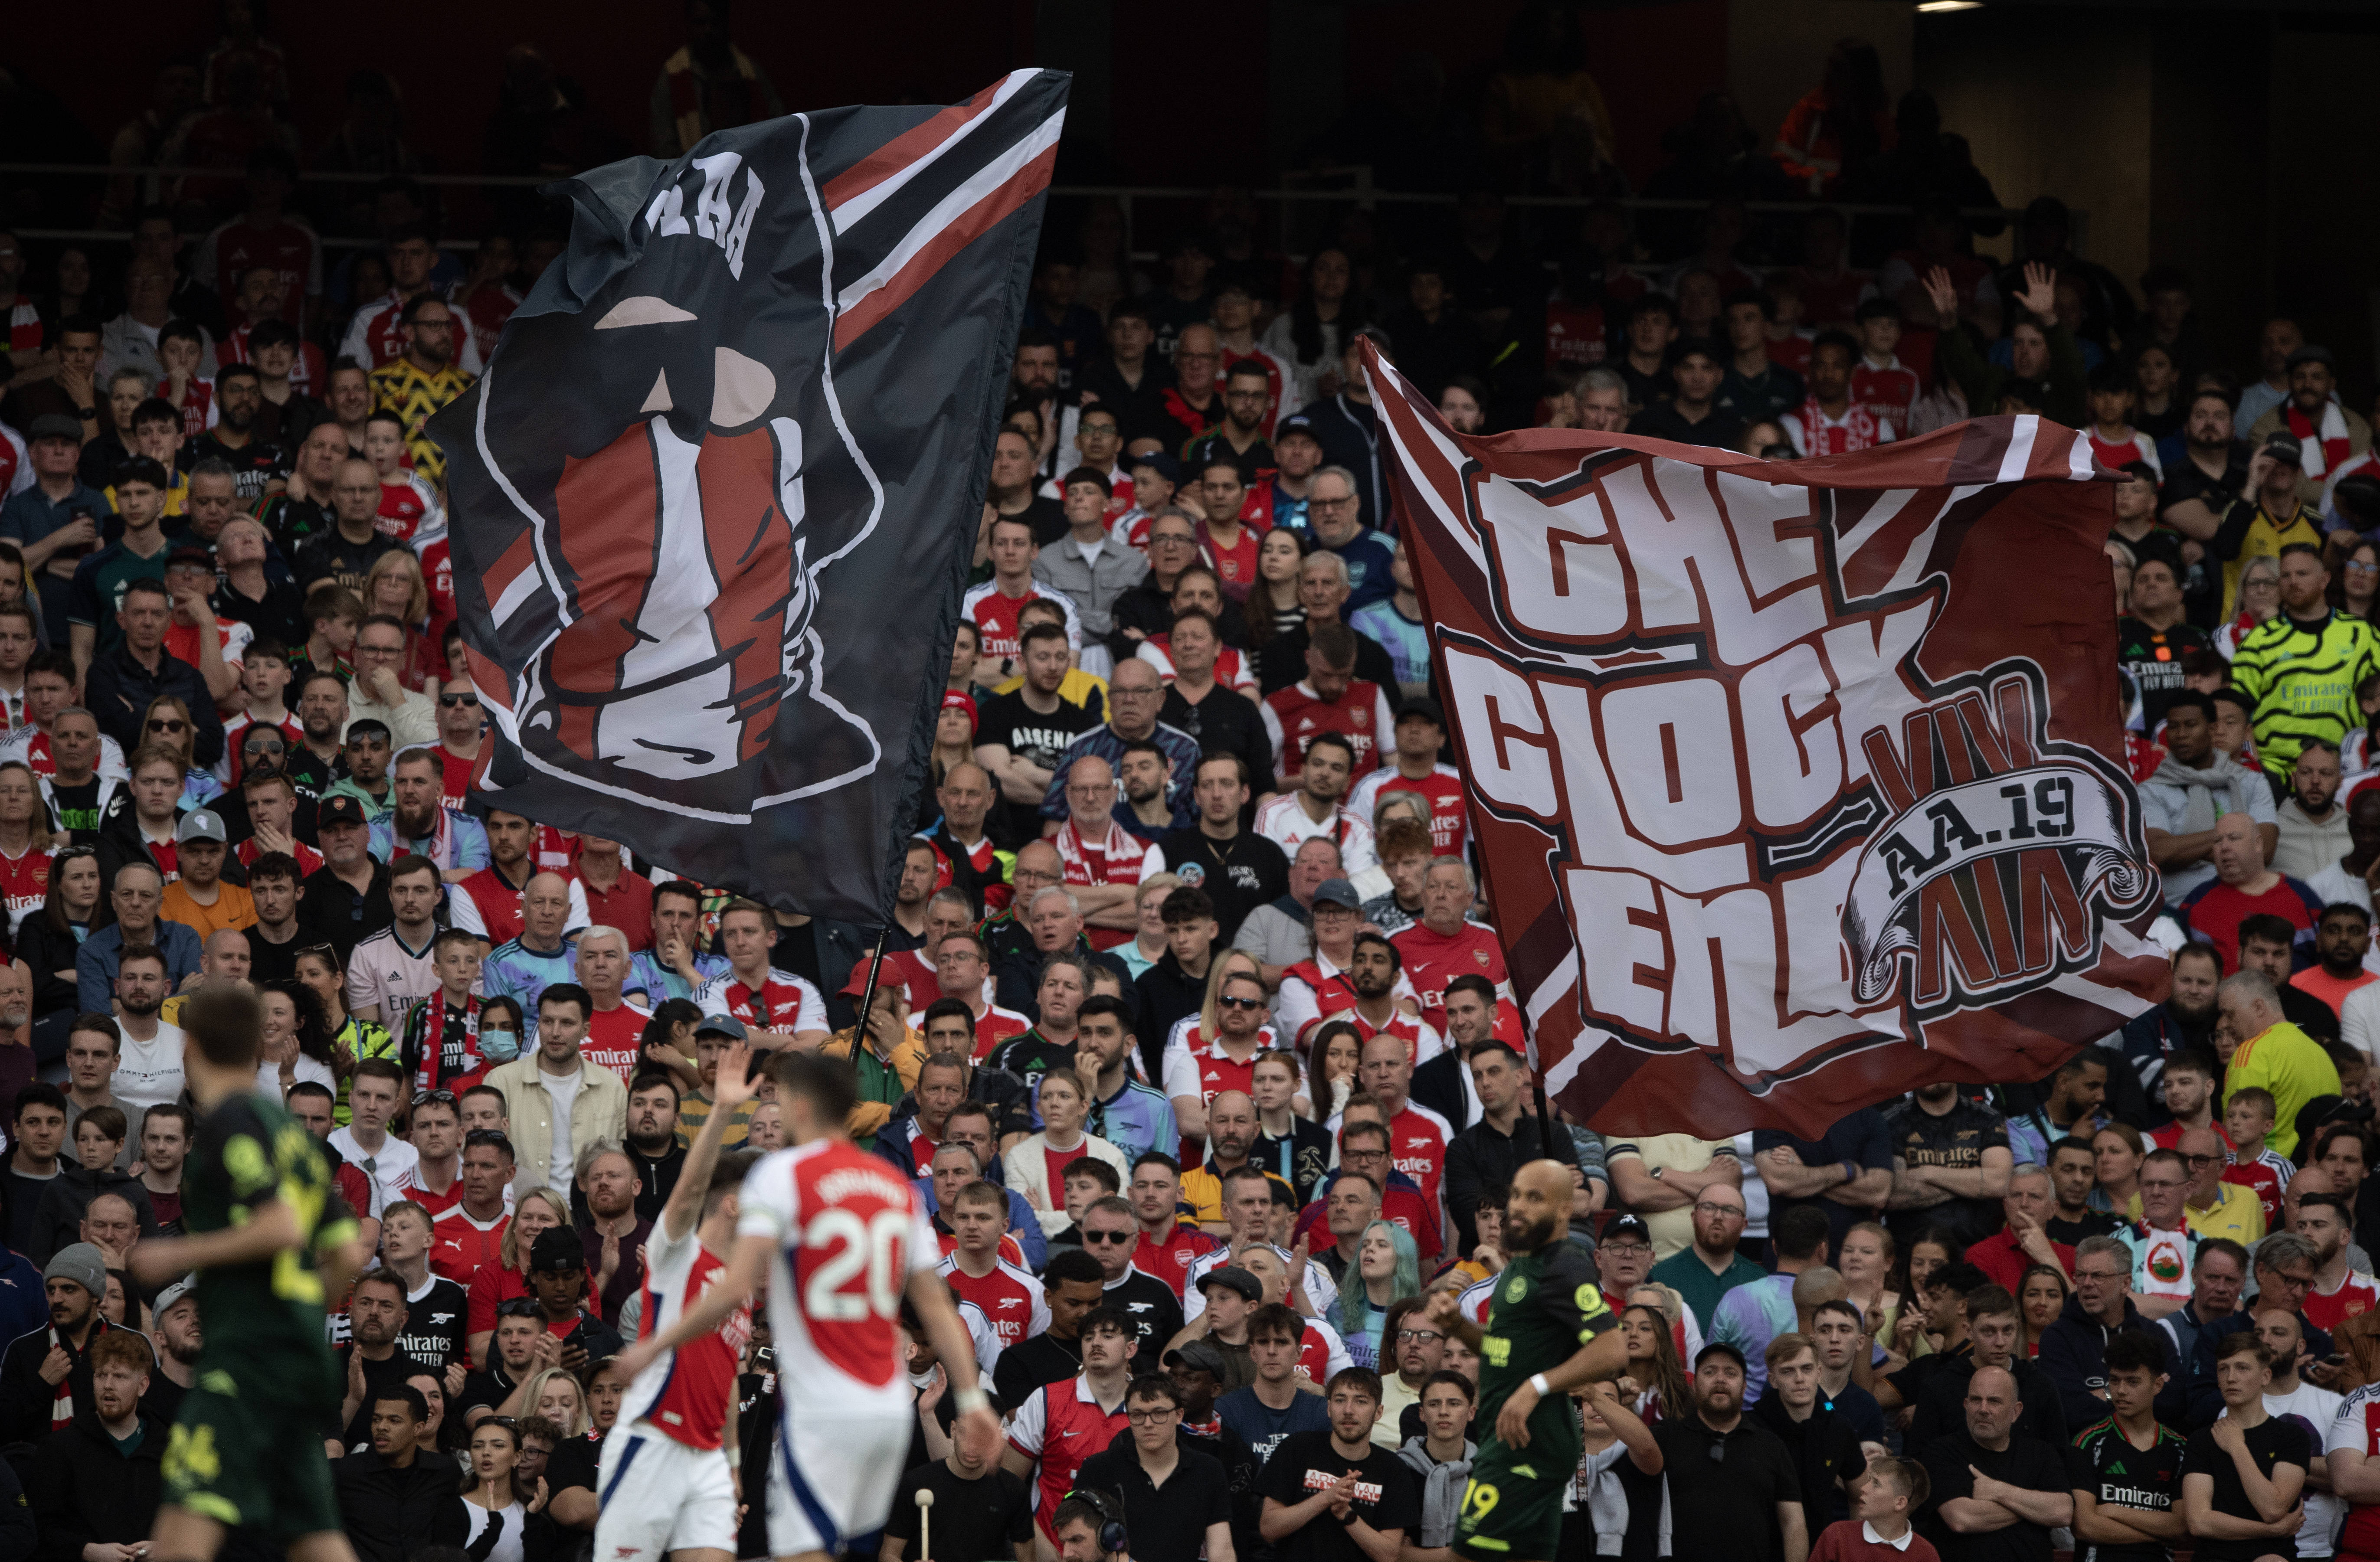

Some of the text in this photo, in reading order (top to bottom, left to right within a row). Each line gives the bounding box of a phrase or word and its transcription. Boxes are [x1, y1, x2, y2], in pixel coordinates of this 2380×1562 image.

[1477, 456, 1827, 666] THE
[1444, 596, 1935, 894] CLOCK
[1878, 776, 2075, 900] AA.19
[1907, 1148, 1979, 1164] Emirates
[805, 1207, 911, 1321] 20
[1461, 1479, 1500, 1520] 19
[2102, 1484, 2170, 1506] Emirates
